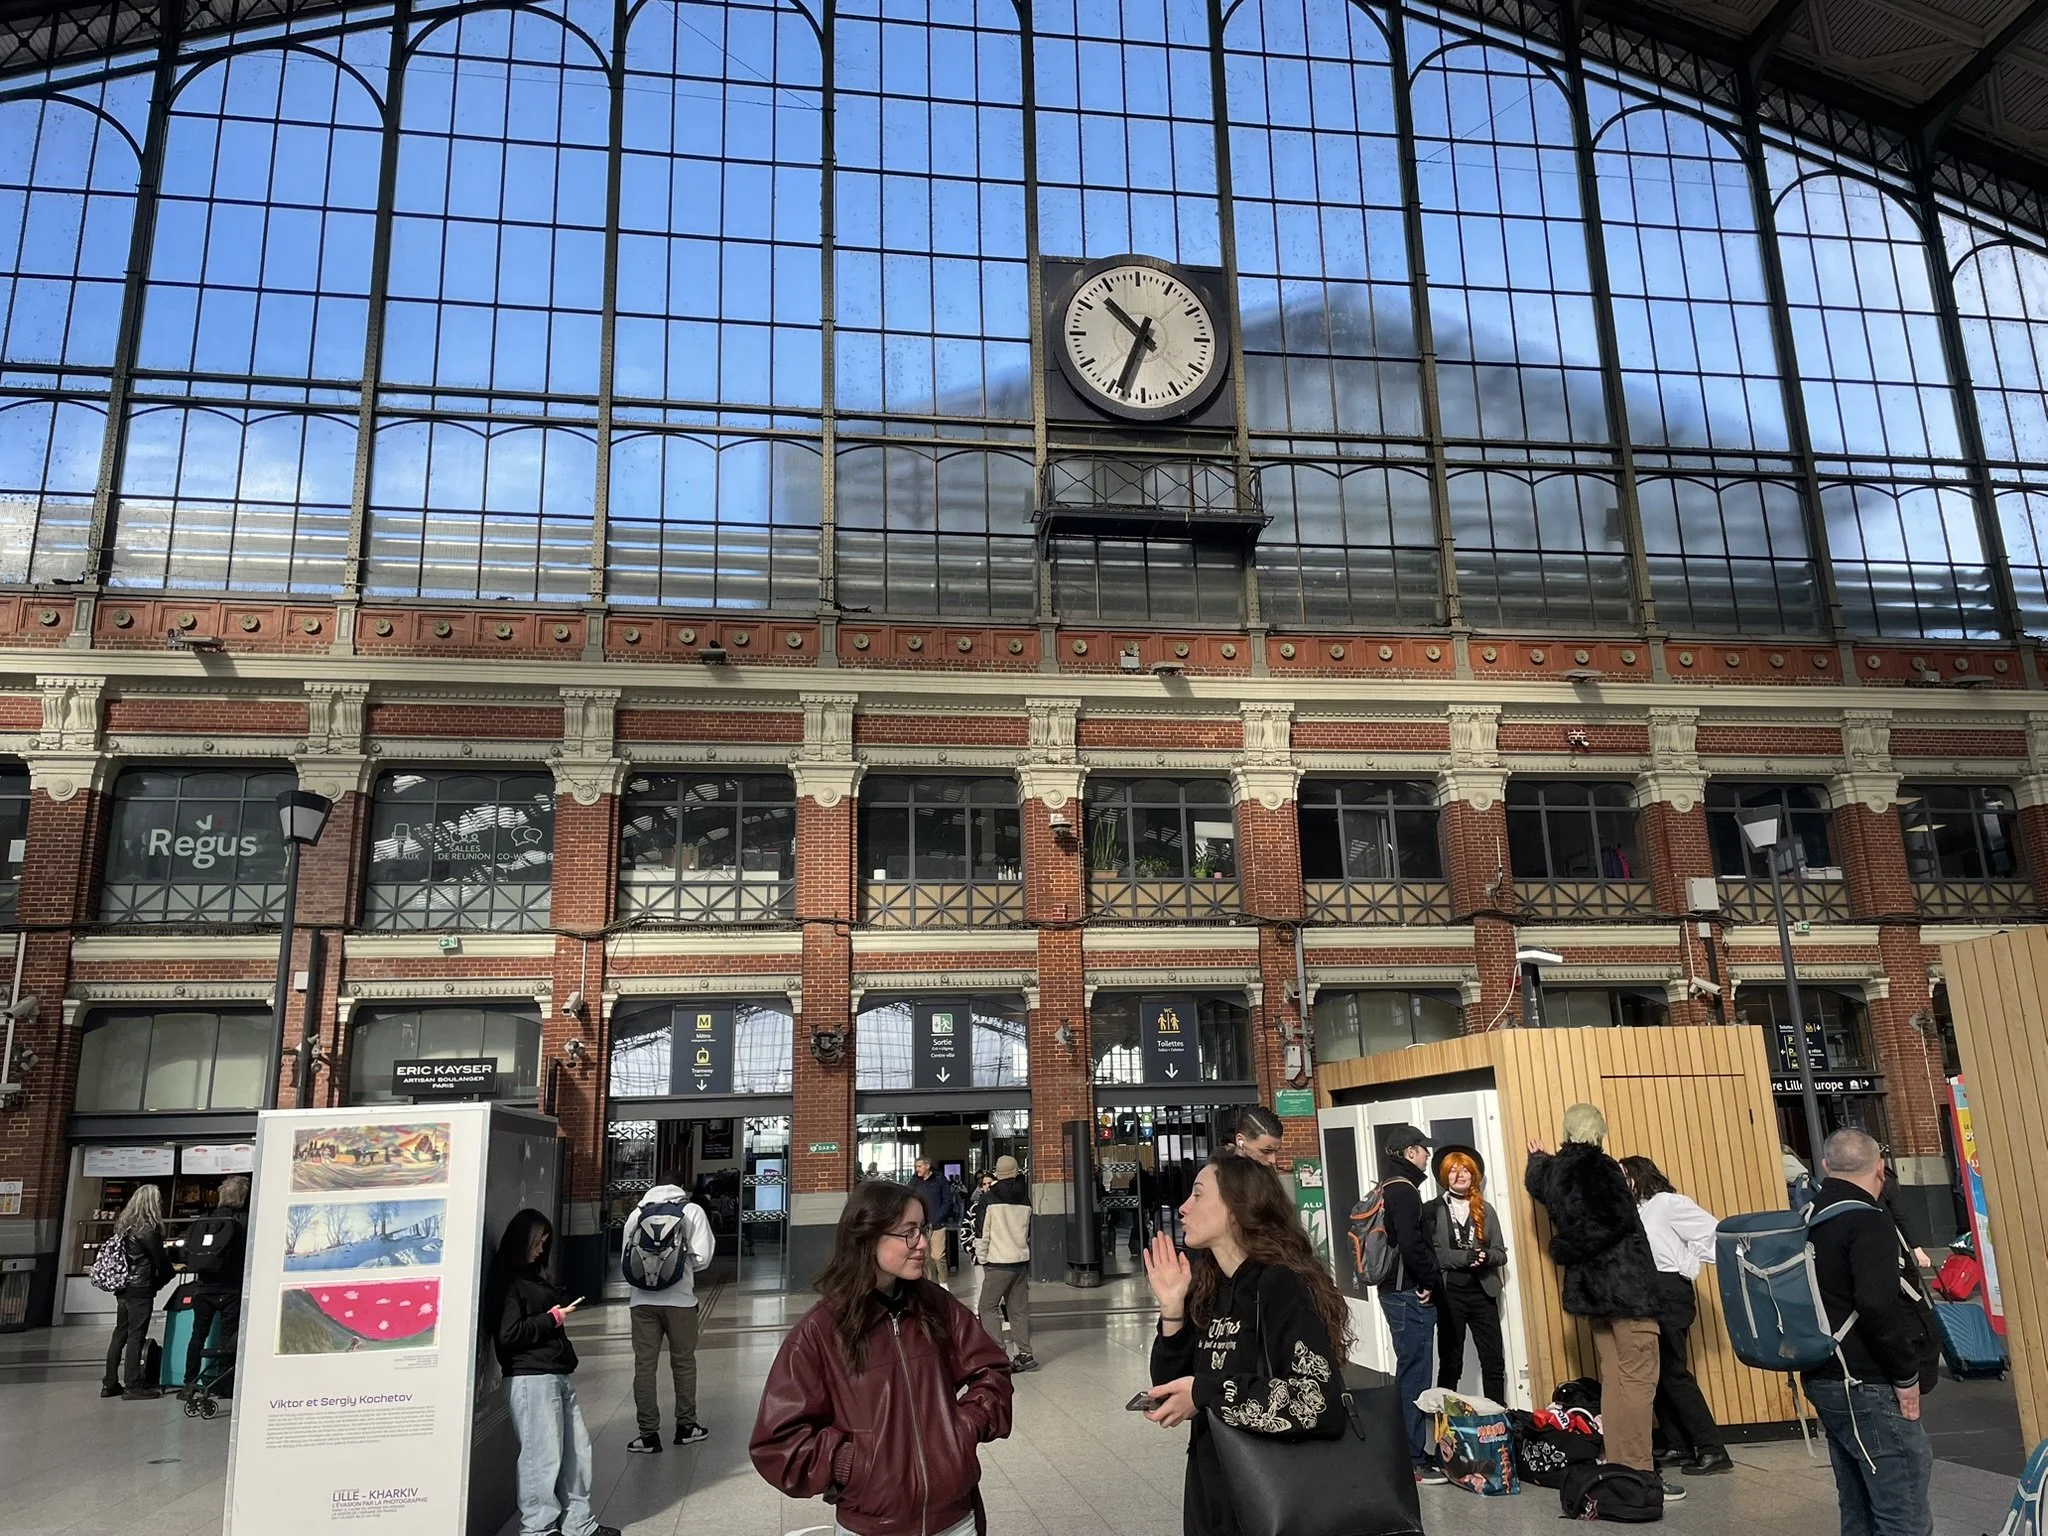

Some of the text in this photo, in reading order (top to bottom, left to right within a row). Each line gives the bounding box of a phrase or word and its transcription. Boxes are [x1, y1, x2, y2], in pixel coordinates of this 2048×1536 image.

[148, 828, 257, 869] Regus
[449, 845, 481, 853] SALLES
[438, 853, 450, 861] DE
[932, 1038, 953, 1046] Sortie
[396, 1064, 492, 1076] ERIC KAYSER
[1772, 1082, 1783, 1091] re
[1815, 1081, 1844, 1092] urope
[269, 1392, 414, 1410] Viktor et Sergiy Kochetov
[332, 1491, 360, 1502] LILLE
[369, 1487, 419, 1500] KHARKIV
